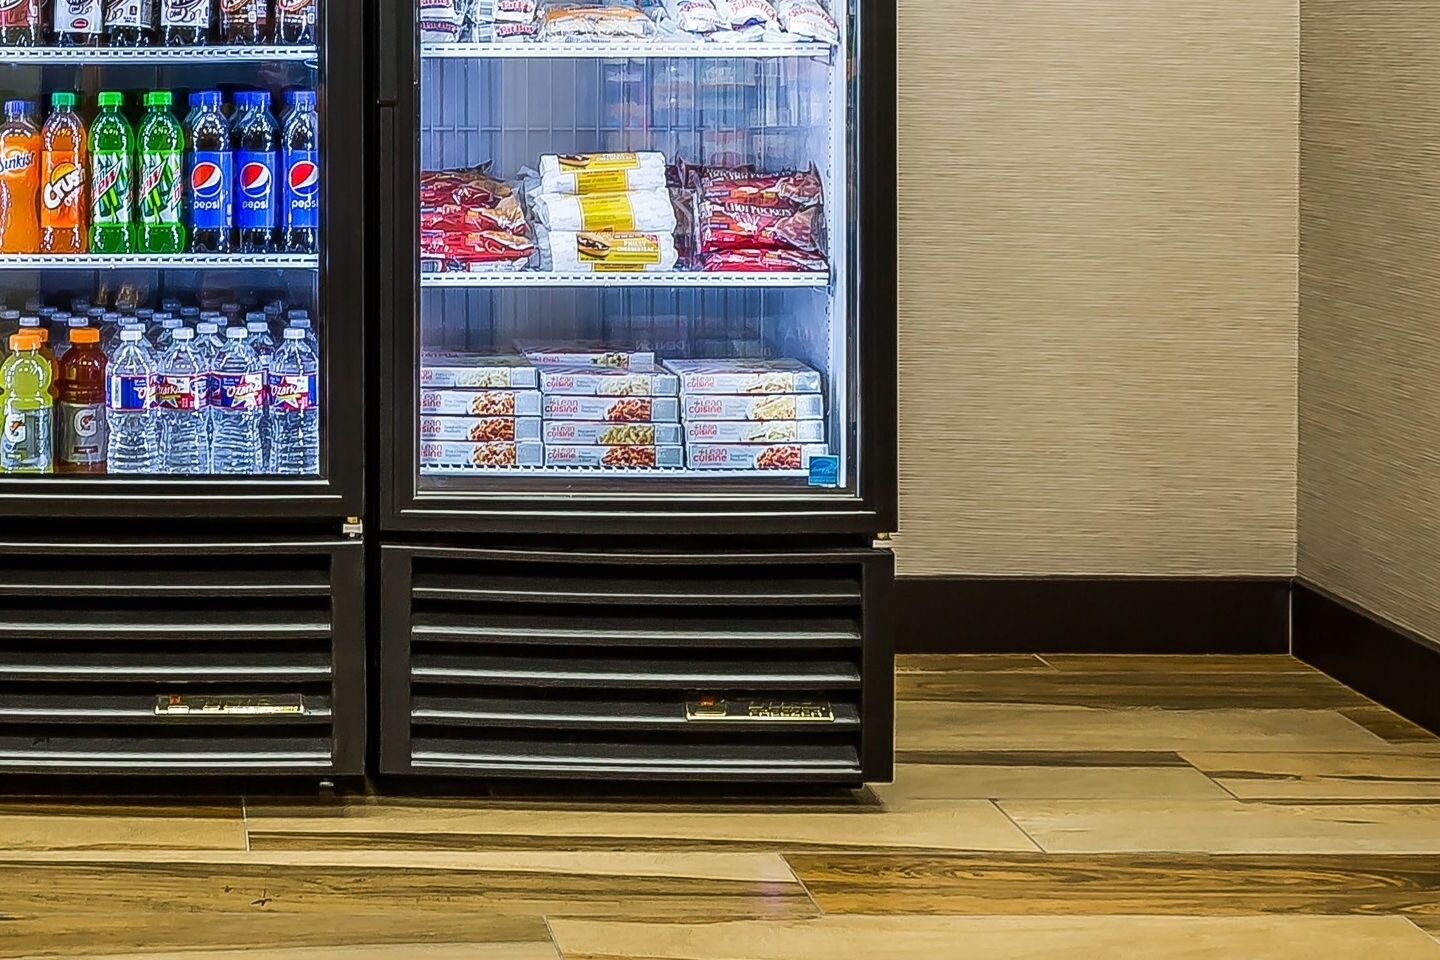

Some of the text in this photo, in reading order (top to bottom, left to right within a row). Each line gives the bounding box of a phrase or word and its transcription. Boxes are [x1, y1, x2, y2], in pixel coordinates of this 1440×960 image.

[193, 200, 221, 210] pepsi
[242, 200, 269, 211] pepsi
[291, 199, 319, 211] pepsi
[5, 413, 27, 443] G
[74, 409, 98, 438] G
